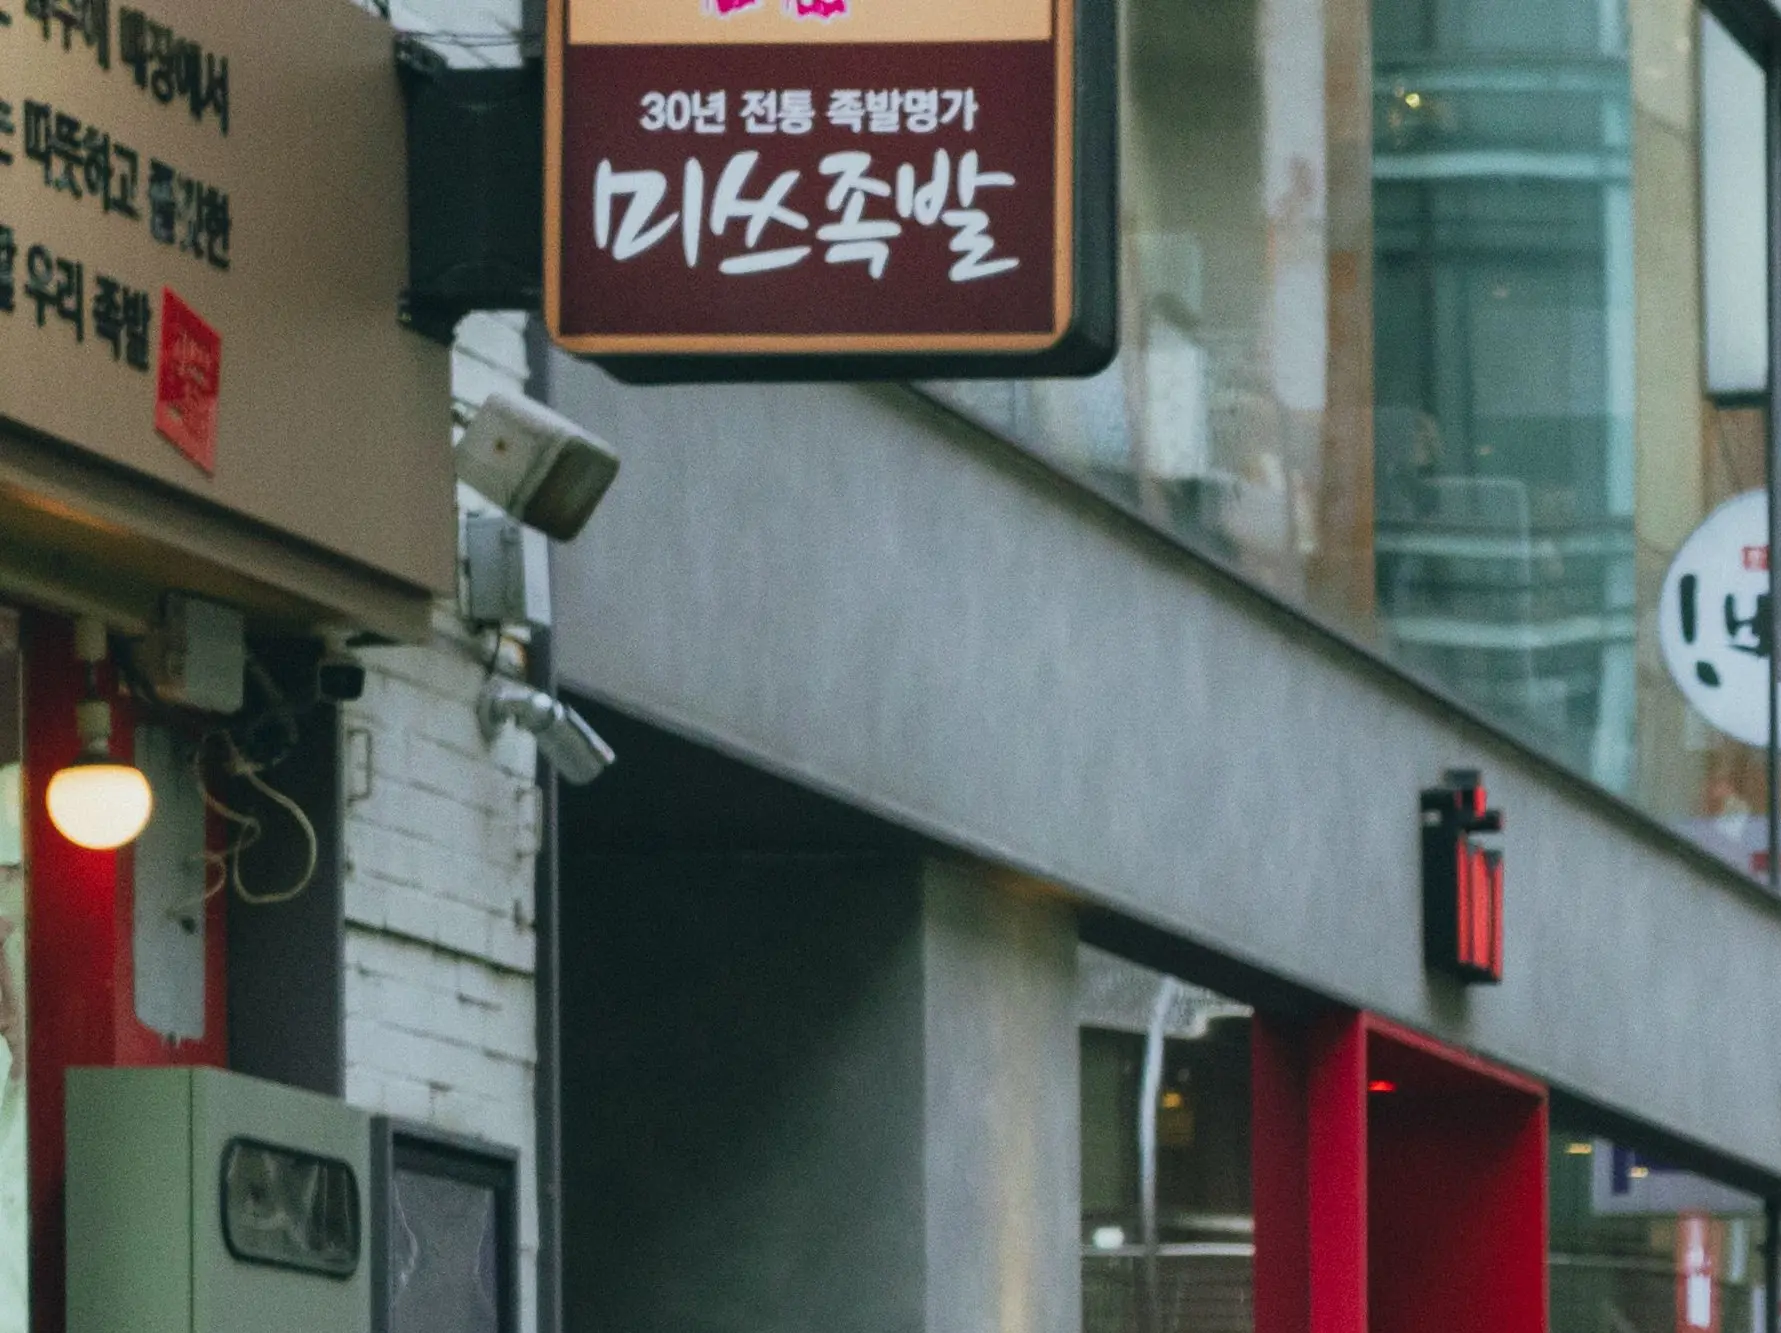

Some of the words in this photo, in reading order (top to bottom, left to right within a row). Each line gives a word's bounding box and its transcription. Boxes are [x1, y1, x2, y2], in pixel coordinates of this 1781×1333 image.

[640, 90, 727, 133] 30년
[739, 88, 815, 134] 전통
[828, 87, 978, 133] 족발명가
[593, 148, 1020, 282] 미쓰족발
[25, 244, 83, 342] 우리
[93, 275, 150, 373] 족발
